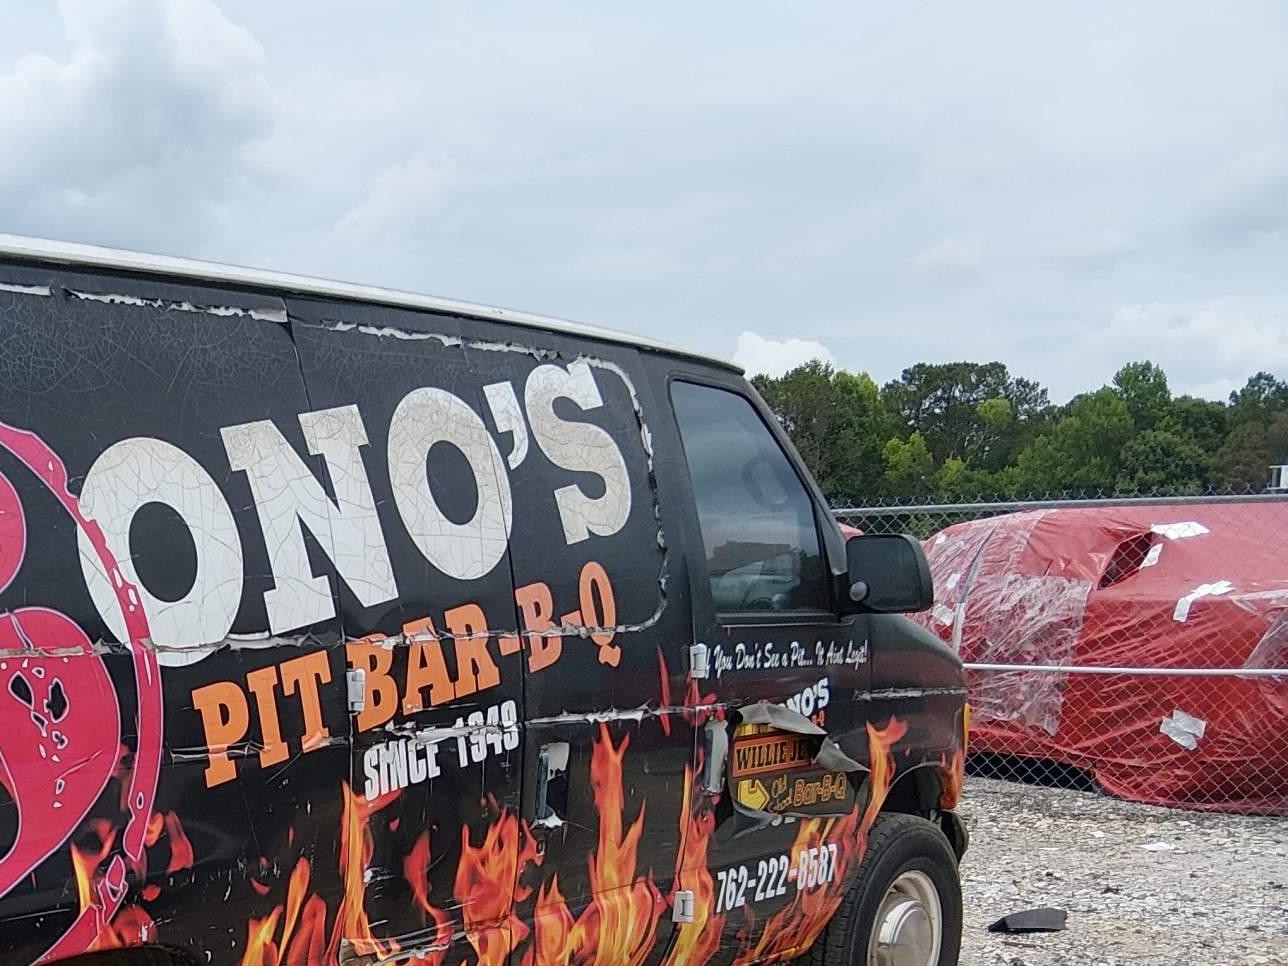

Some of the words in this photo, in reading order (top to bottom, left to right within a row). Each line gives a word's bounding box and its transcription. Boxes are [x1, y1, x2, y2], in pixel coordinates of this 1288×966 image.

[191, 650, 331, 788] PIT
[345, 560, 621, 733] BAR-B-Q
[714, 645, 733, 679] You
[736, 642, 762, 670] Don't
[764, 642, 780, 669] See
[781, 652, 789, 668] a
[815, 640, 825, 667] It
[779, 677, 829, 717] NO'S
[363, 730, 441, 801] SINCE
[452, 700, 519, 768] 1949
[736, 741, 787, 770] WILLIE
[793, 772, 847, 807] Bar-B-Q
[715, 843, 837, 913] 762-222-8587
